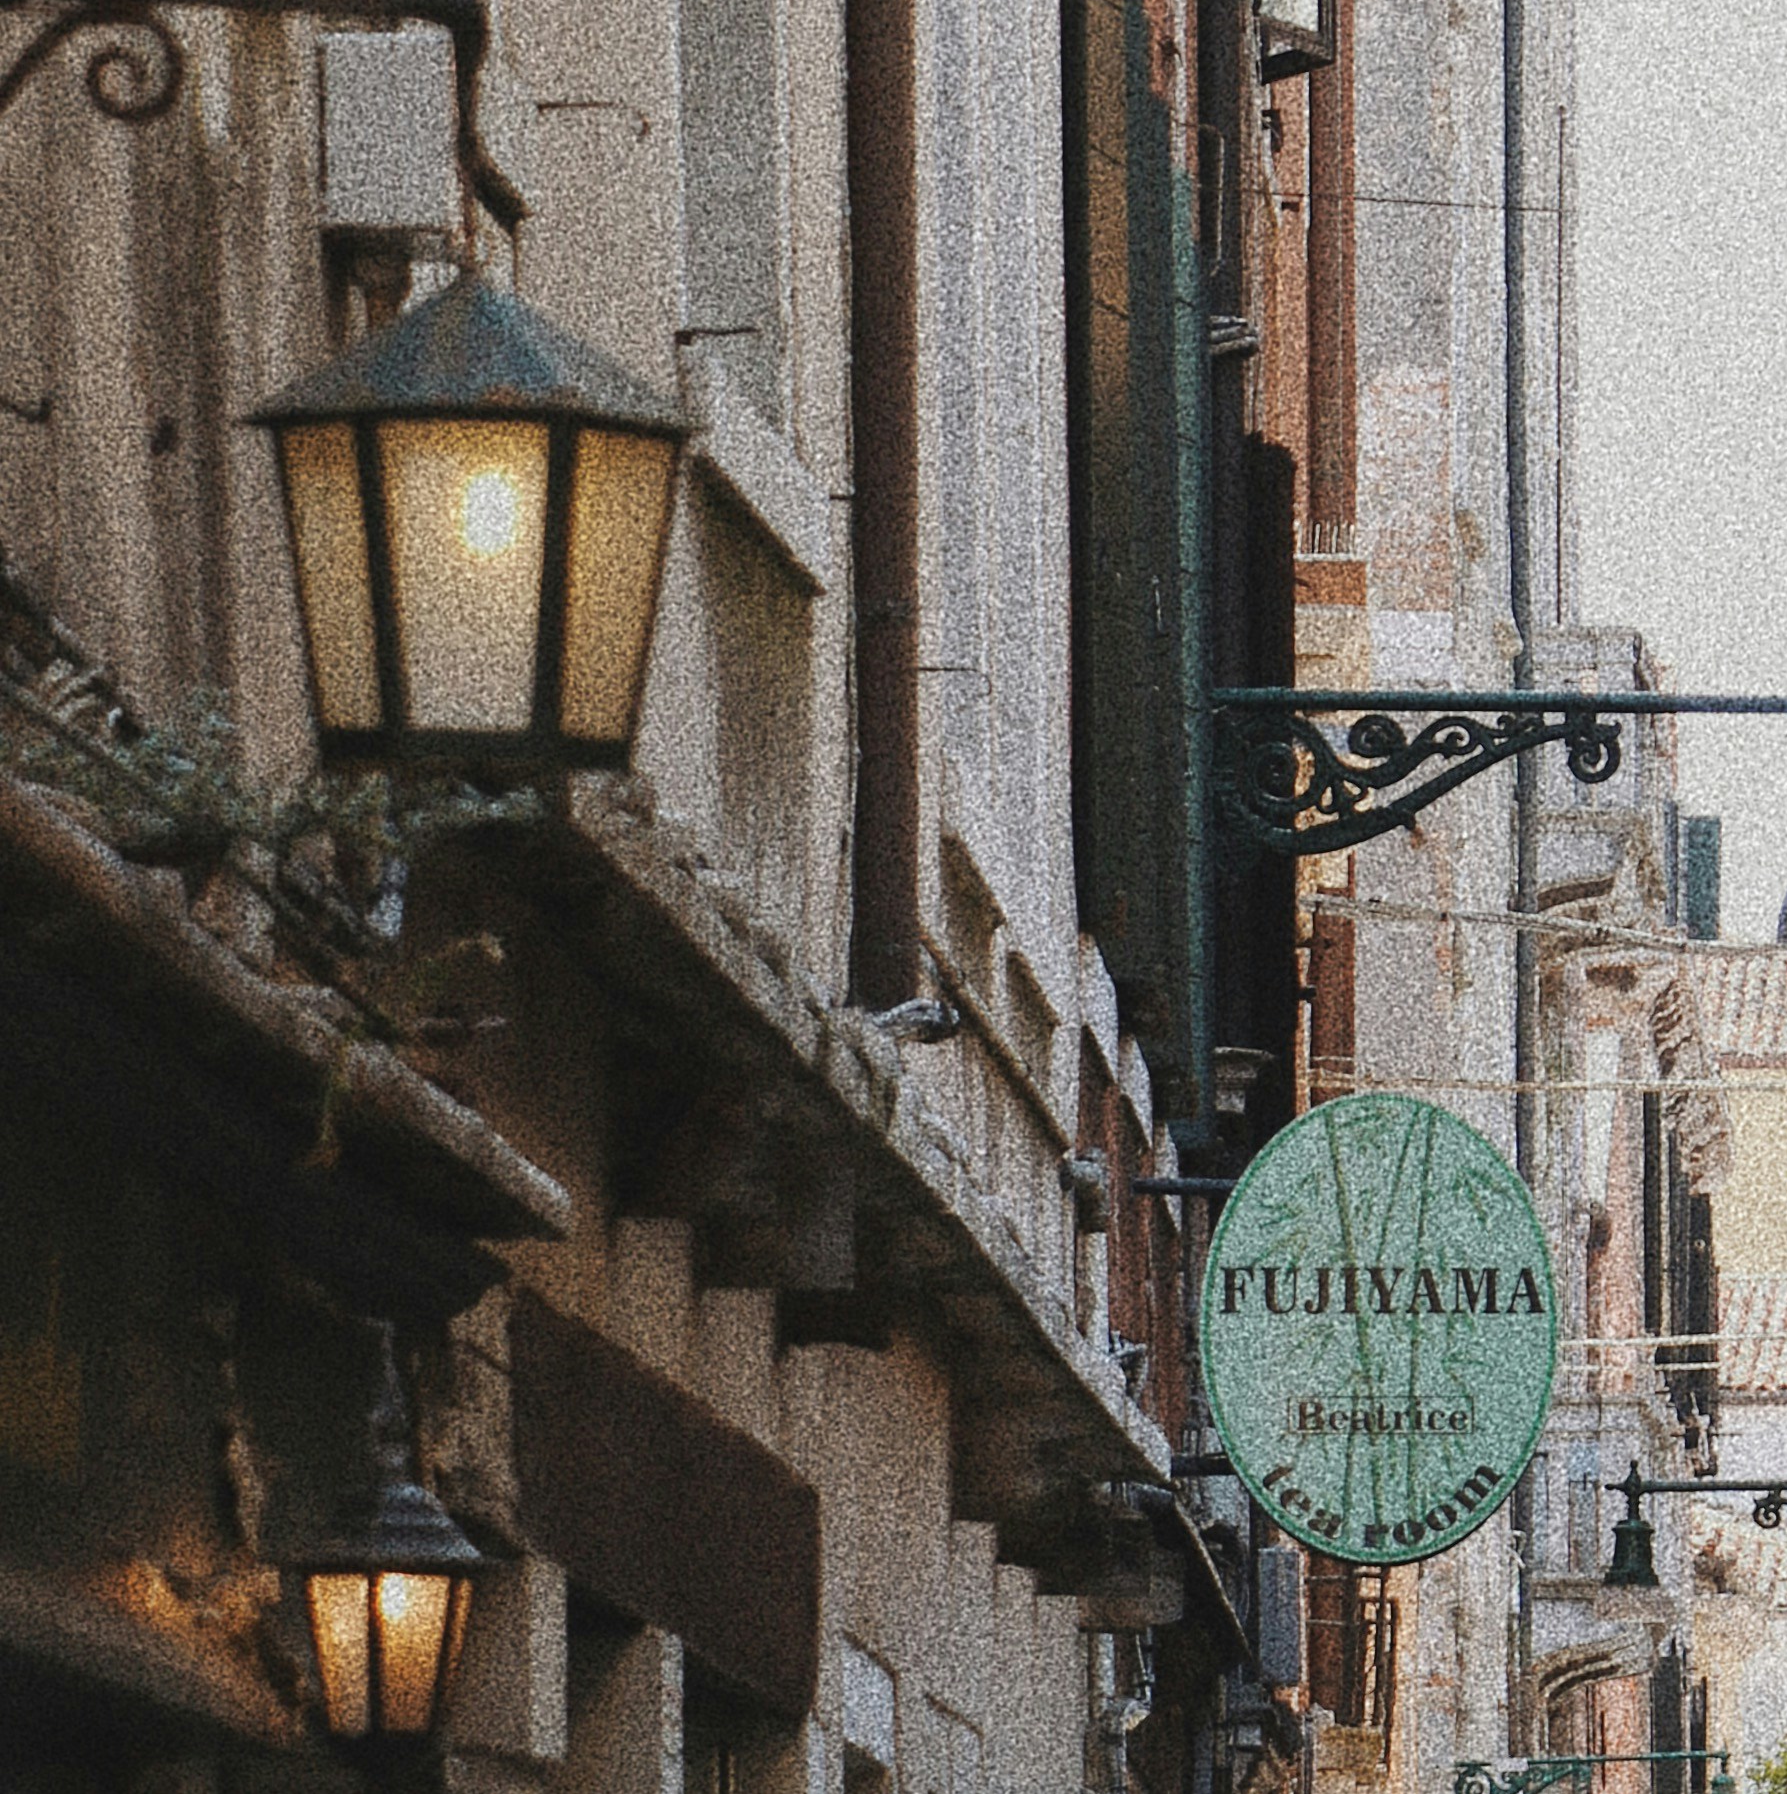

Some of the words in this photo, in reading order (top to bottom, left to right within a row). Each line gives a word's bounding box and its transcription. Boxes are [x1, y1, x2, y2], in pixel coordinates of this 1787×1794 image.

[1219, 1266, 1547, 1315] FUJIYAMA
[1297, 1400, 1470, 1432] Beatrice
[1262, 1464, 1342, 1540] tea
[1364, 1465, 1503, 1548] room
